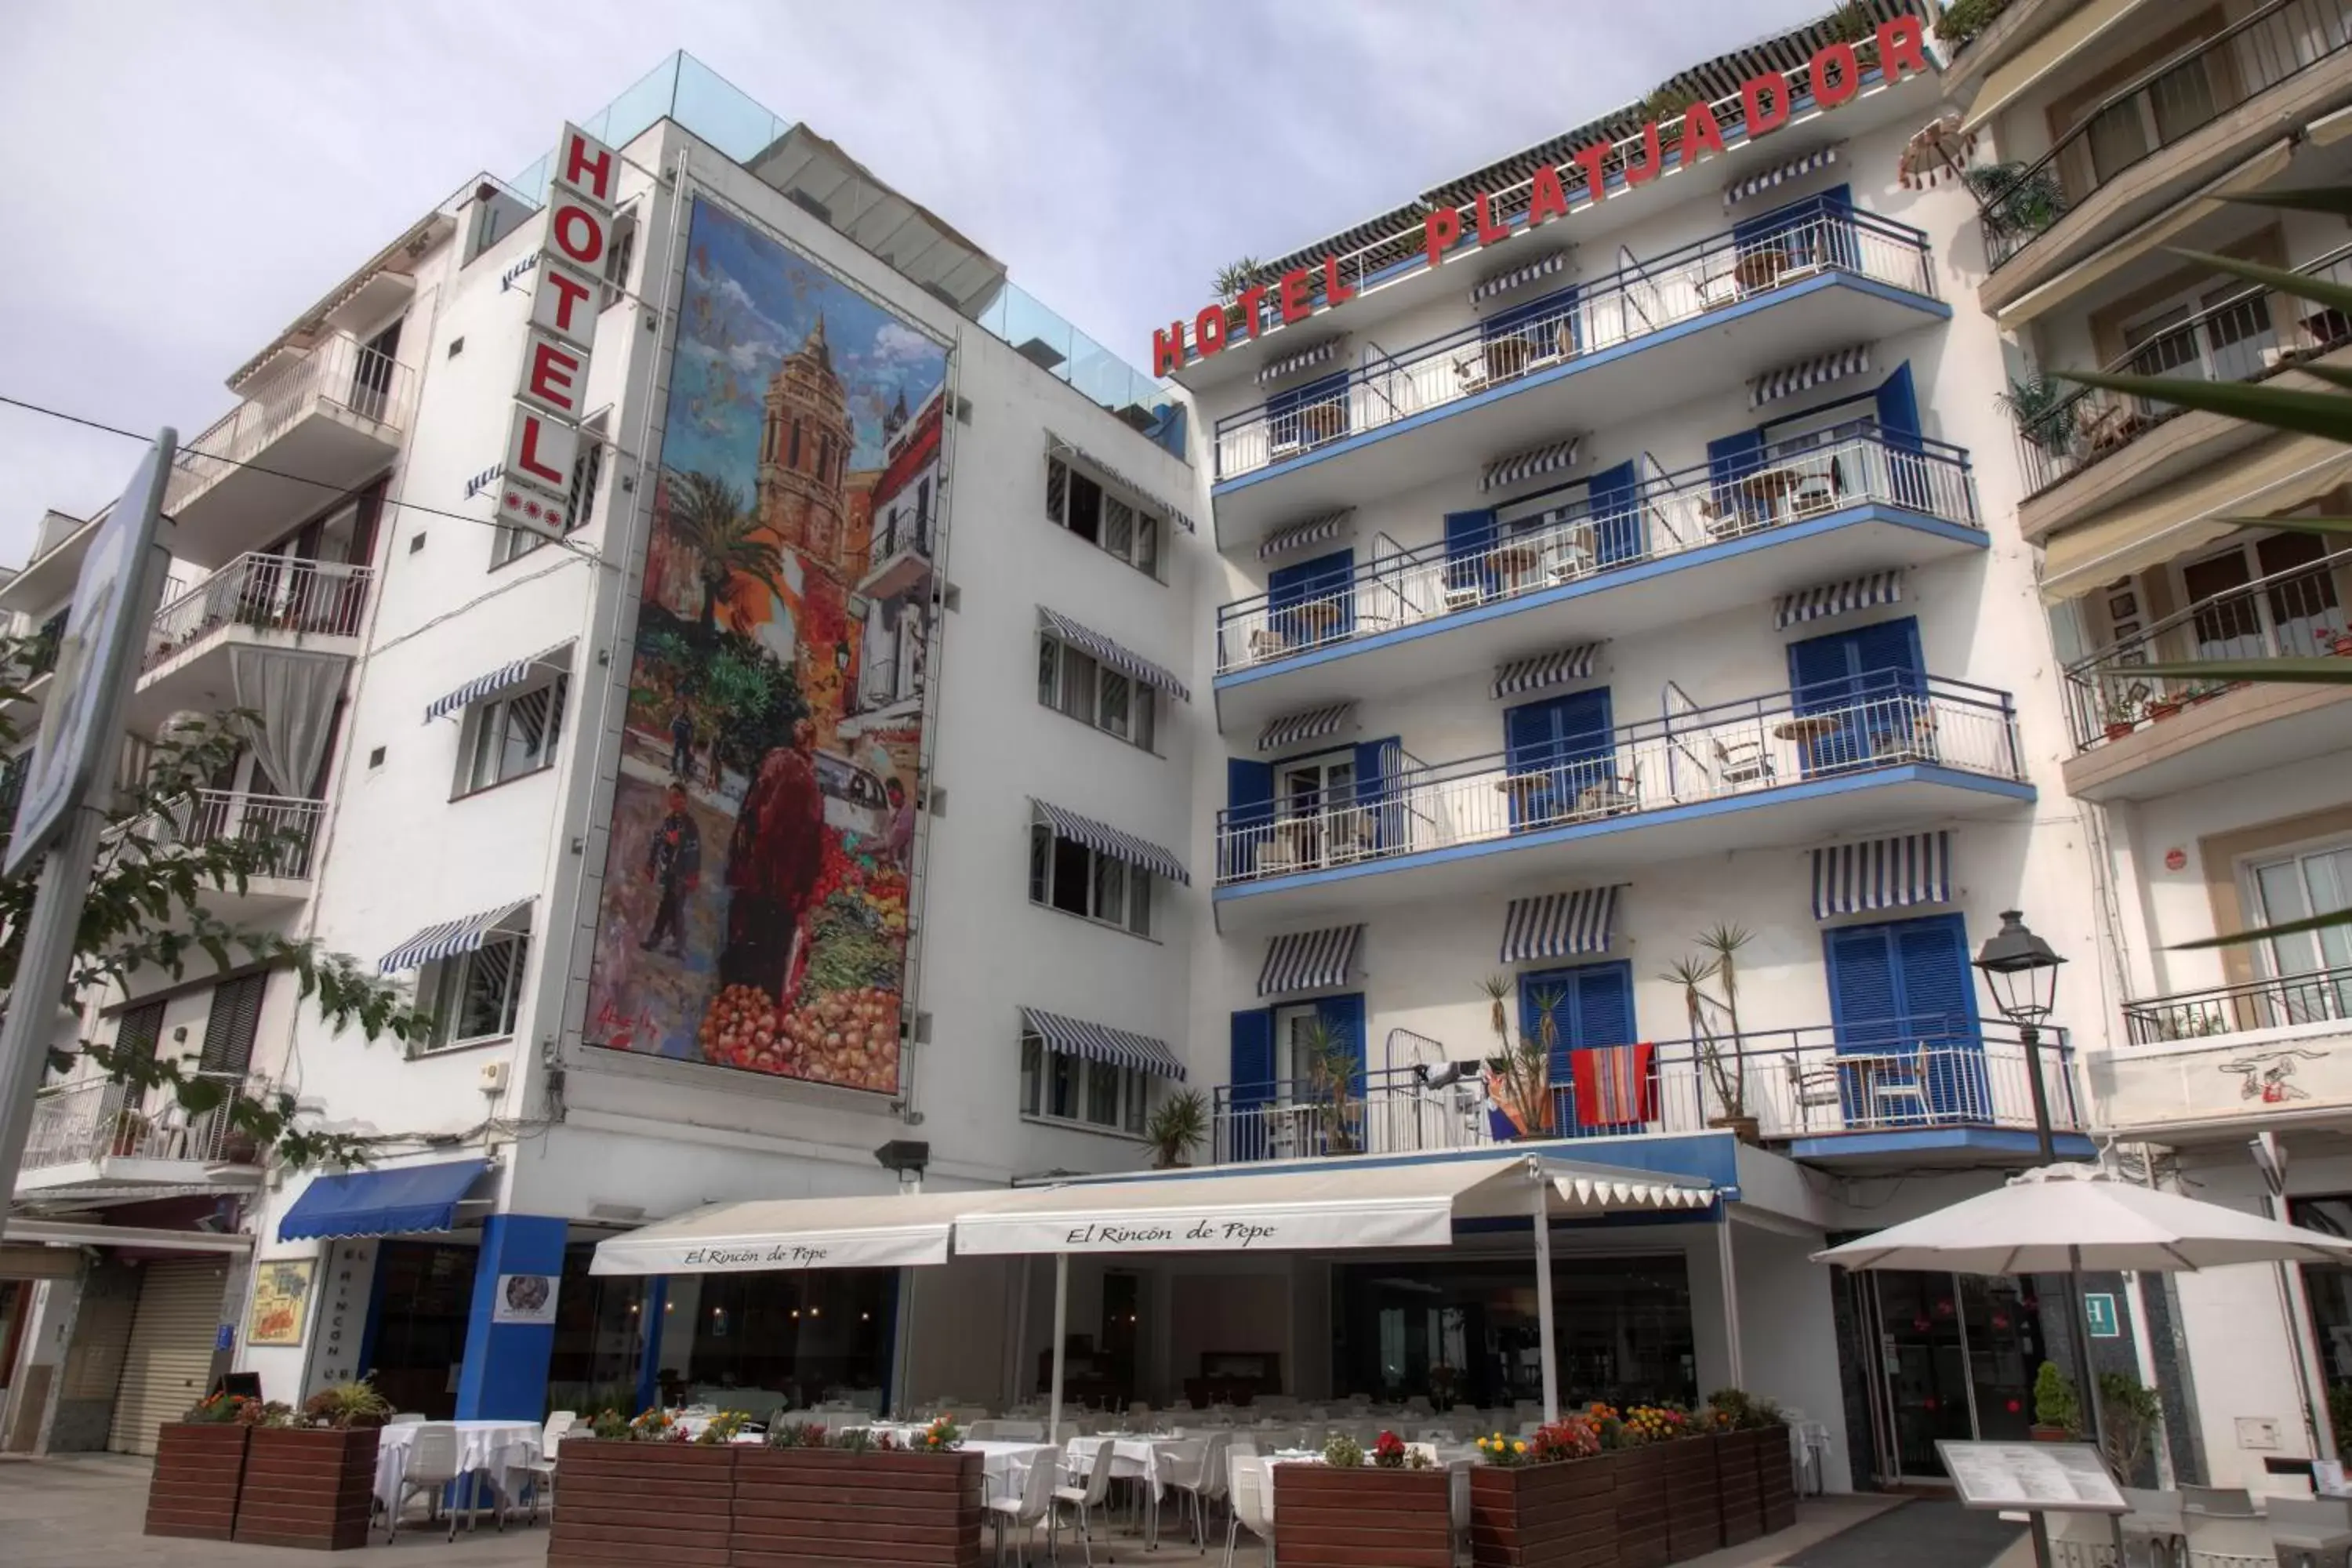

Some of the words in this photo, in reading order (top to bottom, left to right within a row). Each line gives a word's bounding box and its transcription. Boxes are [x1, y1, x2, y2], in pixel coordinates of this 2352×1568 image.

[1152, 252, 1359, 378] HOTEL
[1425, 14, 1928, 267] PLATJADOR
[518, 132, 612, 485] HOTEL
[684, 1247, 706, 1265] El
[707, 1250, 759, 1265] Rincón
[766, 1244, 786, 1261] de
[791, 1247, 828, 1268] Pepe
[1065, 1223, 1095, 1243] El
[1098, 1226, 1173, 1244] Rincón
[1185, 1219, 1215, 1240] de
[1221, 1221, 1278, 1247] Pepe
